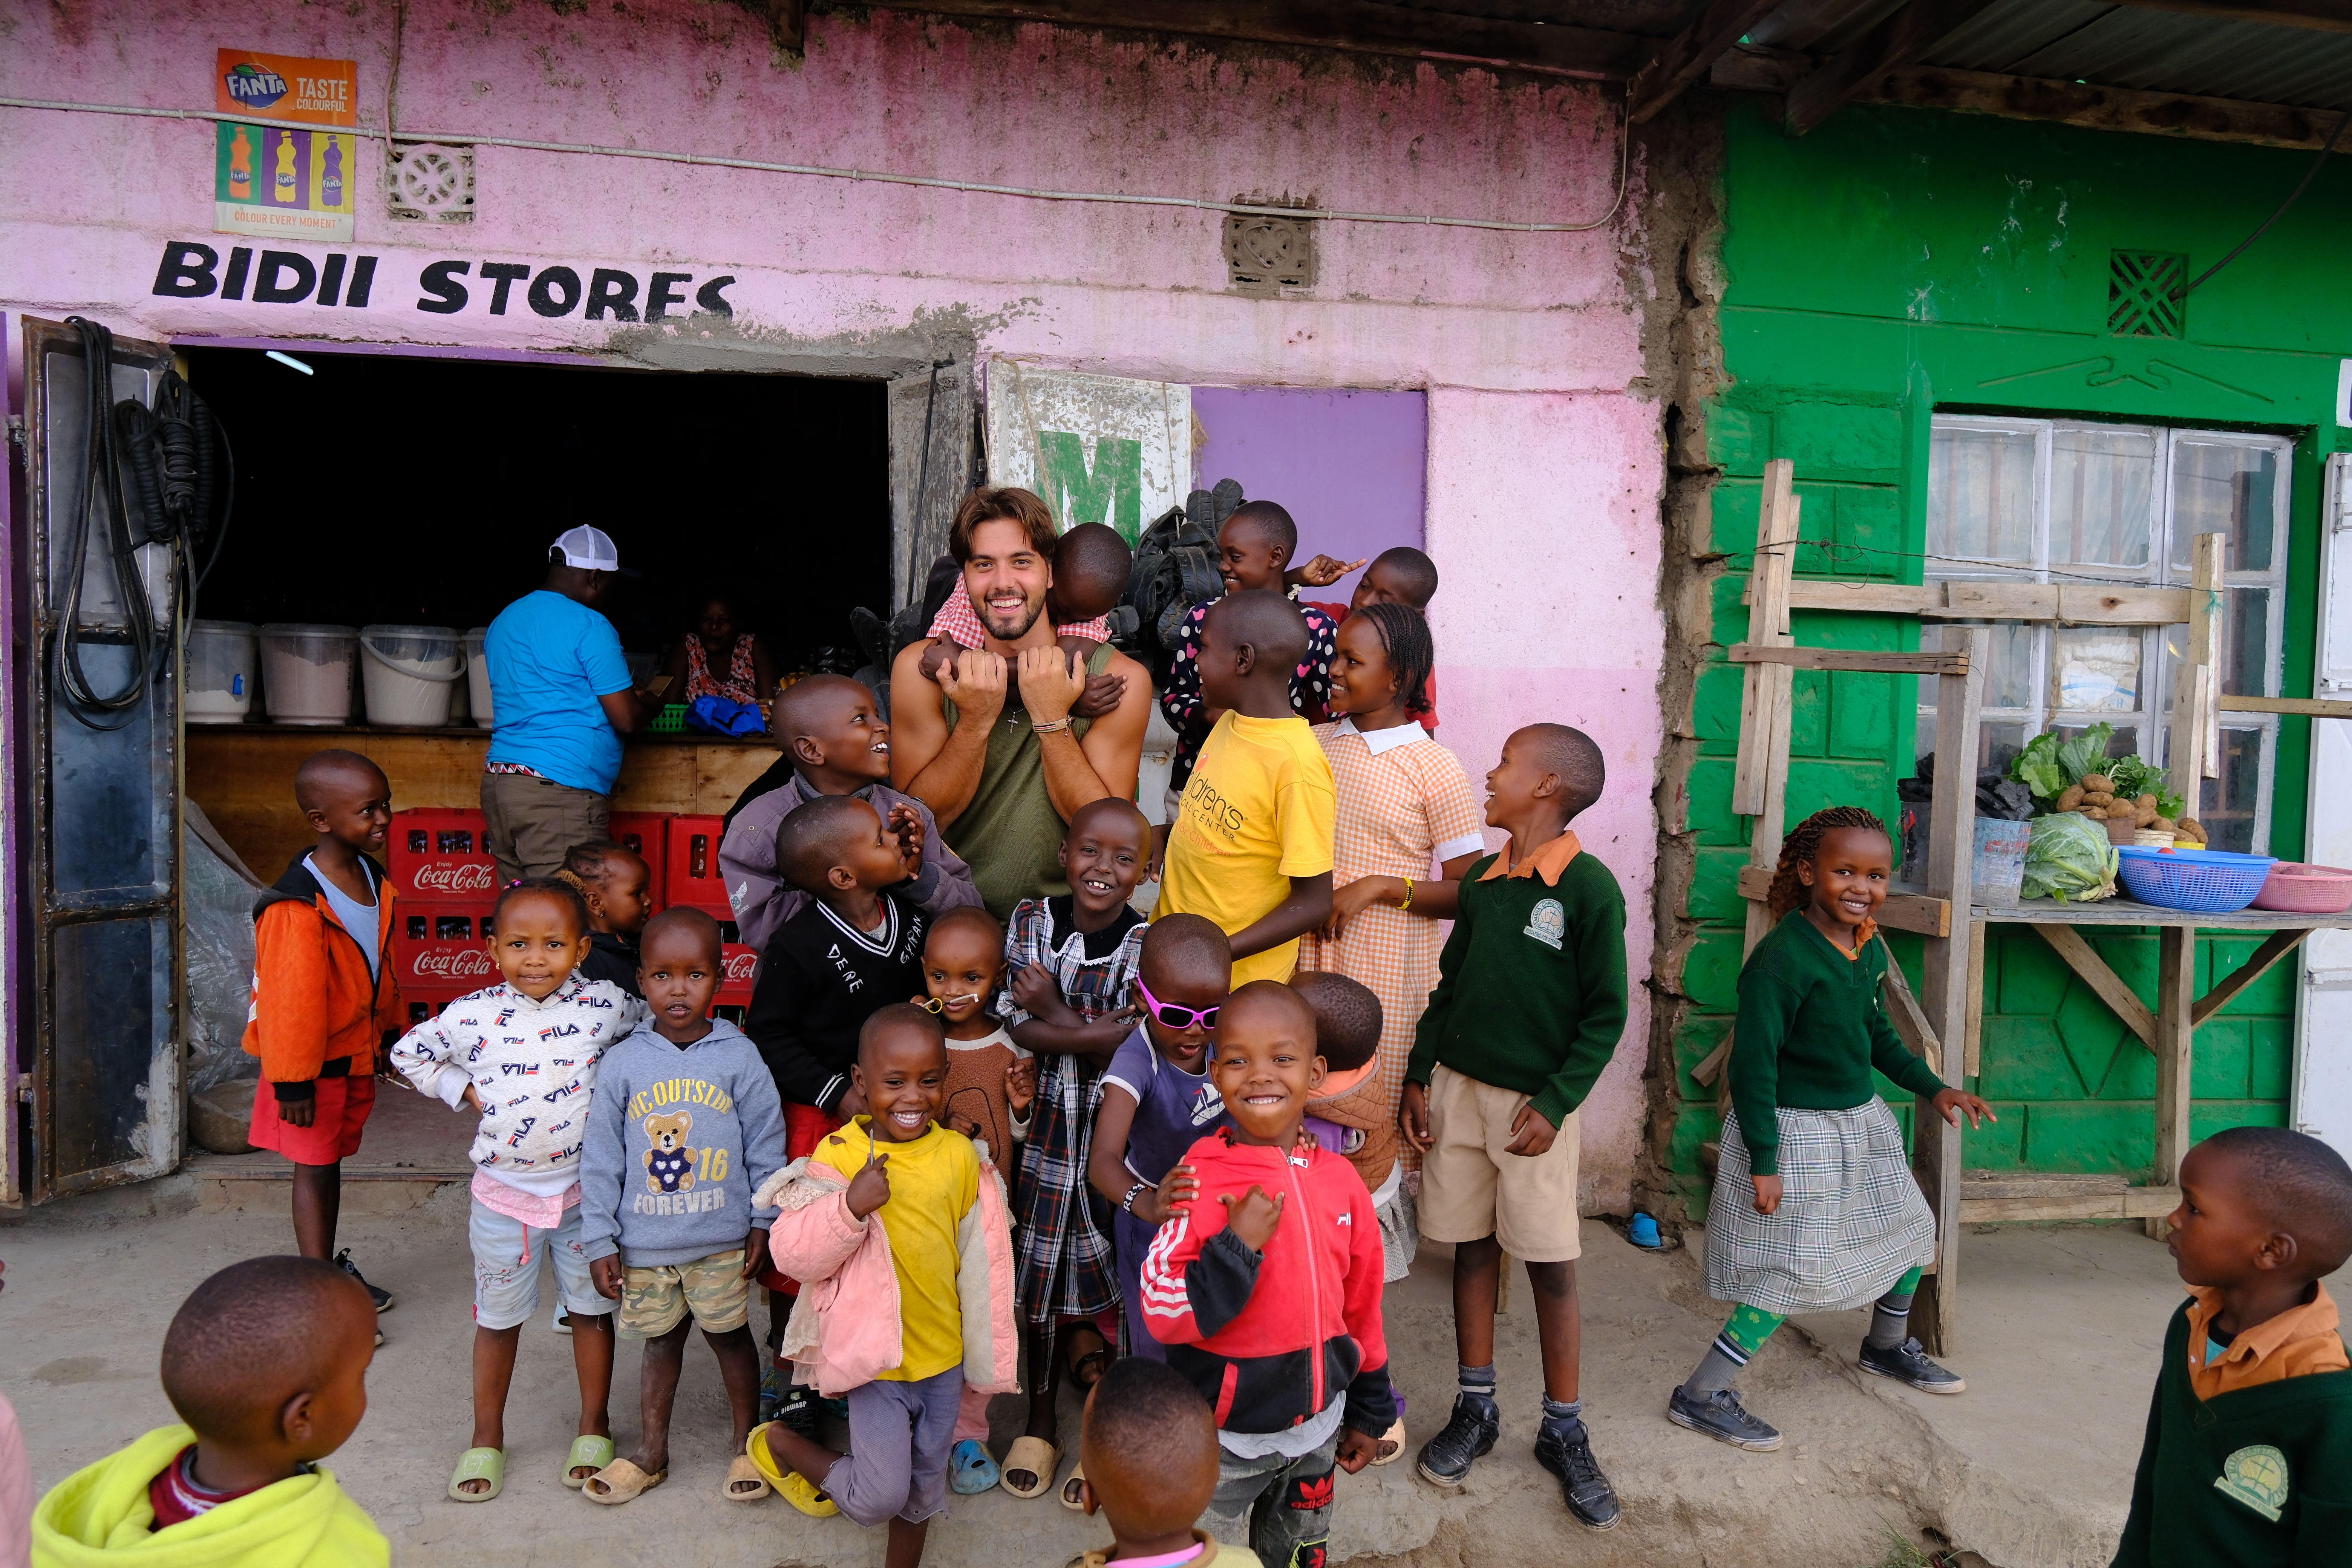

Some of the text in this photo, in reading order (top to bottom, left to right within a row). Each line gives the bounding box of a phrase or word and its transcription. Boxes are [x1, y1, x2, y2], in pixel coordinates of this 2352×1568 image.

[227, 74, 287, 96] FANTA
[297, 77, 348, 100] TASTE
[297, 98, 347, 112] COLOURFUL
[230, 172, 251, 181] FANTA
[276, 176, 296, 184] FANTA
[234, 212, 336, 229] COLOUR EVERY MOMENT
[152, 240, 737, 323] BIDII STORES
[1193, 809, 1235, 842] CENTER
[1179, 821, 1231, 857] for Children
[414, 864, 494, 890] Coca-Cola
[413, 950, 490, 975] Coca-Cola
[577, 997, 614, 1008] FILA
[539, 1023, 581, 1041] FILA
[590, 1023, 602, 1037] FILA
[435, 1030, 450, 1049] FILA
[469, 1036, 488, 1062] FILA
[501, 1063, 540, 1075] FILA
[479, 1076, 493, 1086] FILA
[543, 1080, 581, 1102] FILA
[508, 1095, 529, 1107] FILA
[483, 1131, 497, 1140] FILA
[508, 1118, 536, 1147] FILA
[548, 1121, 570, 1133] FILA
[698, 1147, 728, 1182] 16
[634, 1187, 725, 1216] FOREVER
[781, 1401, 807, 1415] BIGWASP
[1291, 1491, 1334, 1509] adida
